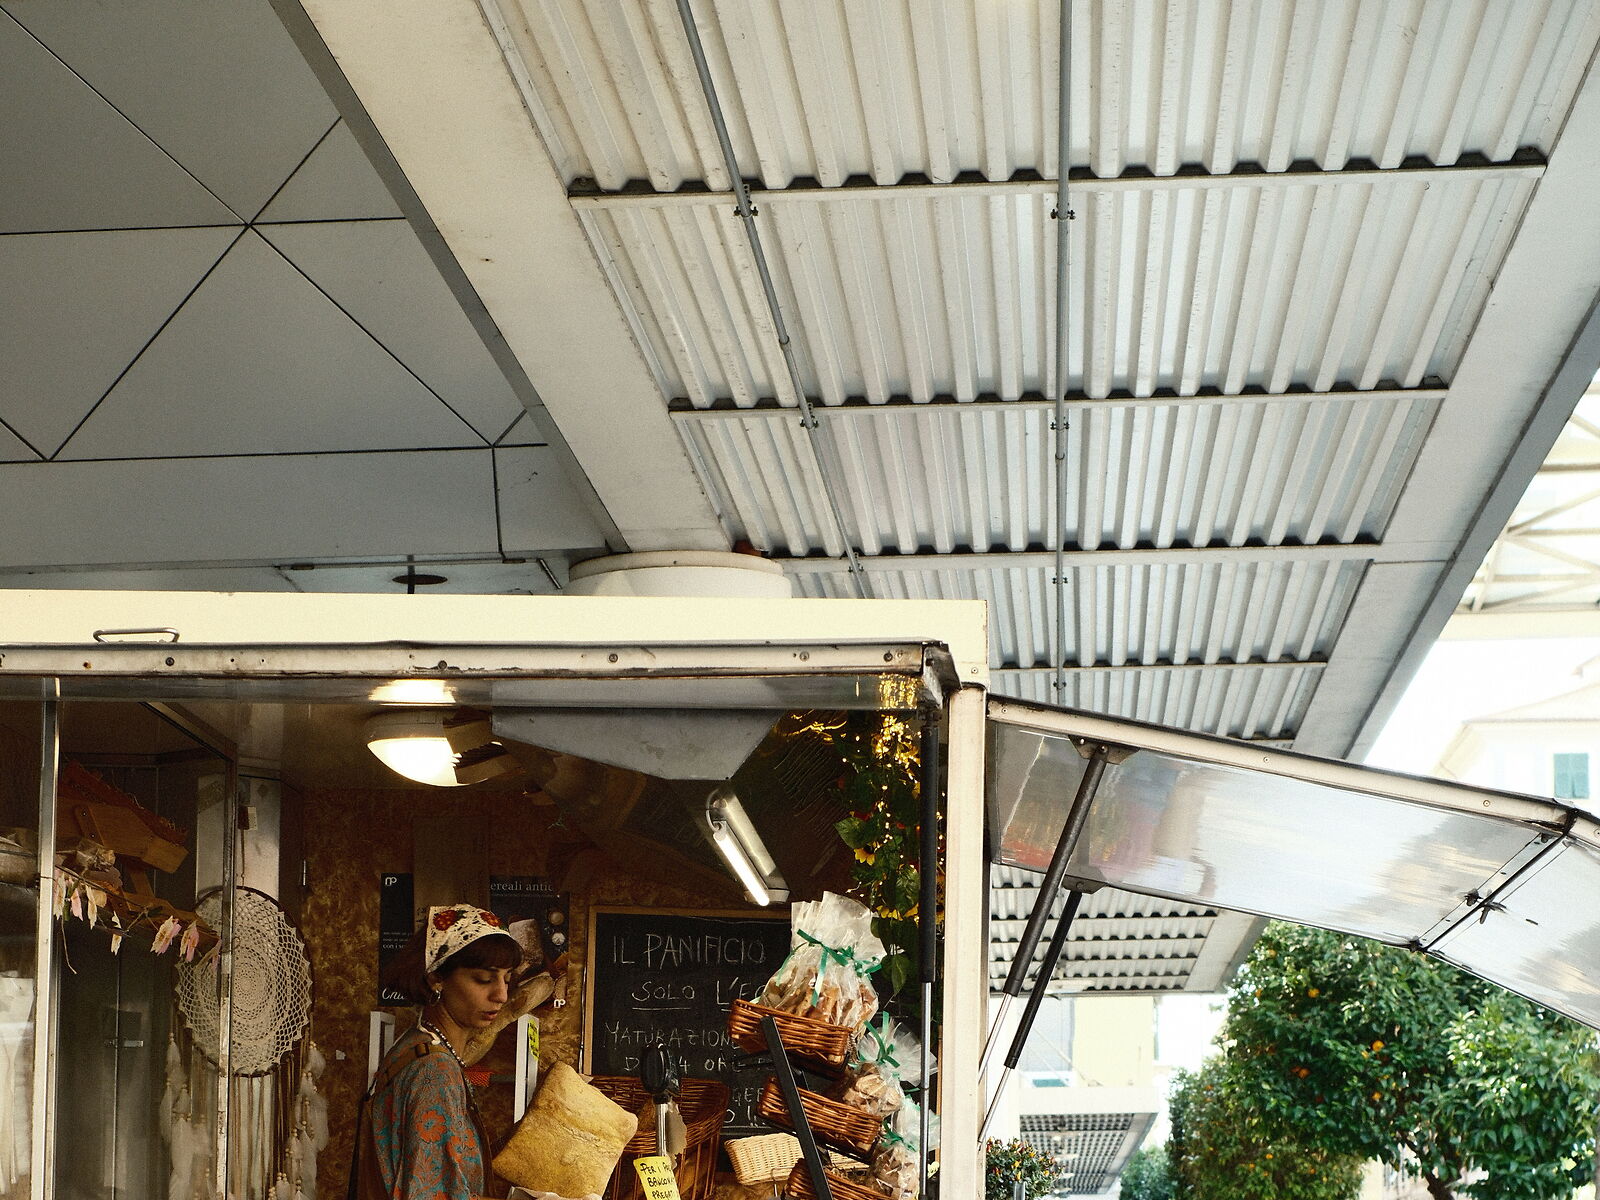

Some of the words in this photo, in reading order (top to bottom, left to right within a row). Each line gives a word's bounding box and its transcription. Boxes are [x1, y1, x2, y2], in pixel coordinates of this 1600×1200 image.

[613, 935, 635, 963] IL
[643, 933, 767, 970] PANIFICIO
[631, 981, 695, 1001] SOLO
